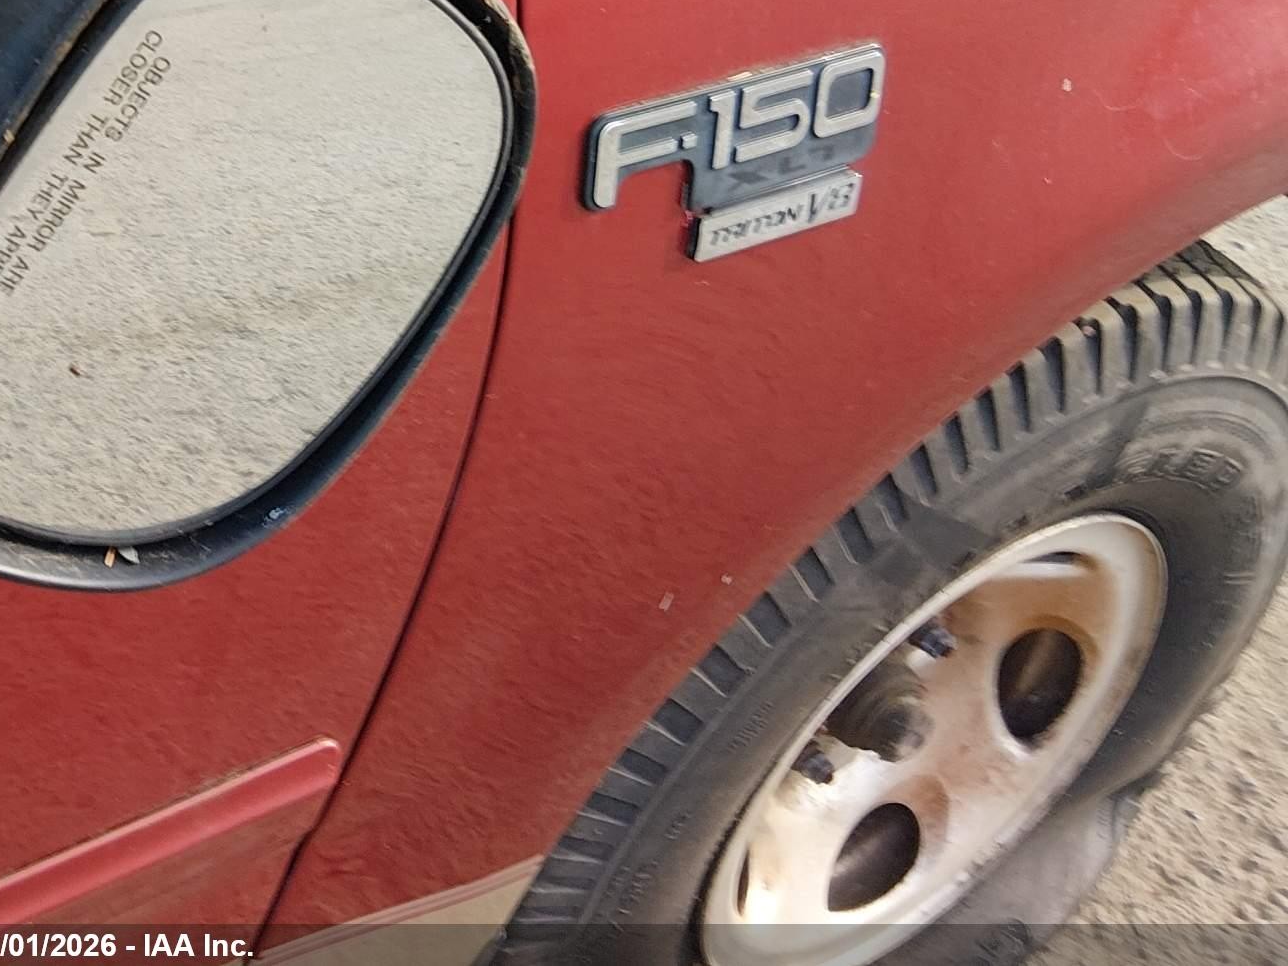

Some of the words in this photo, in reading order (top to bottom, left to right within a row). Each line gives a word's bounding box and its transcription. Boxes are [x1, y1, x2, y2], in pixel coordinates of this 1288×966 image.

[102, 29, 163, 106] CLOSER
[104, 56, 171, 142] OBJECTS
[62, 113, 107, 166] THAN
[592, 48, 886, 209] F-150
[83, 151, 106, 174] IN
[26, 172, 69, 220] THEY
[27, 179, 87, 252] MIRROR
[0, 256, 31, 294] ARE
